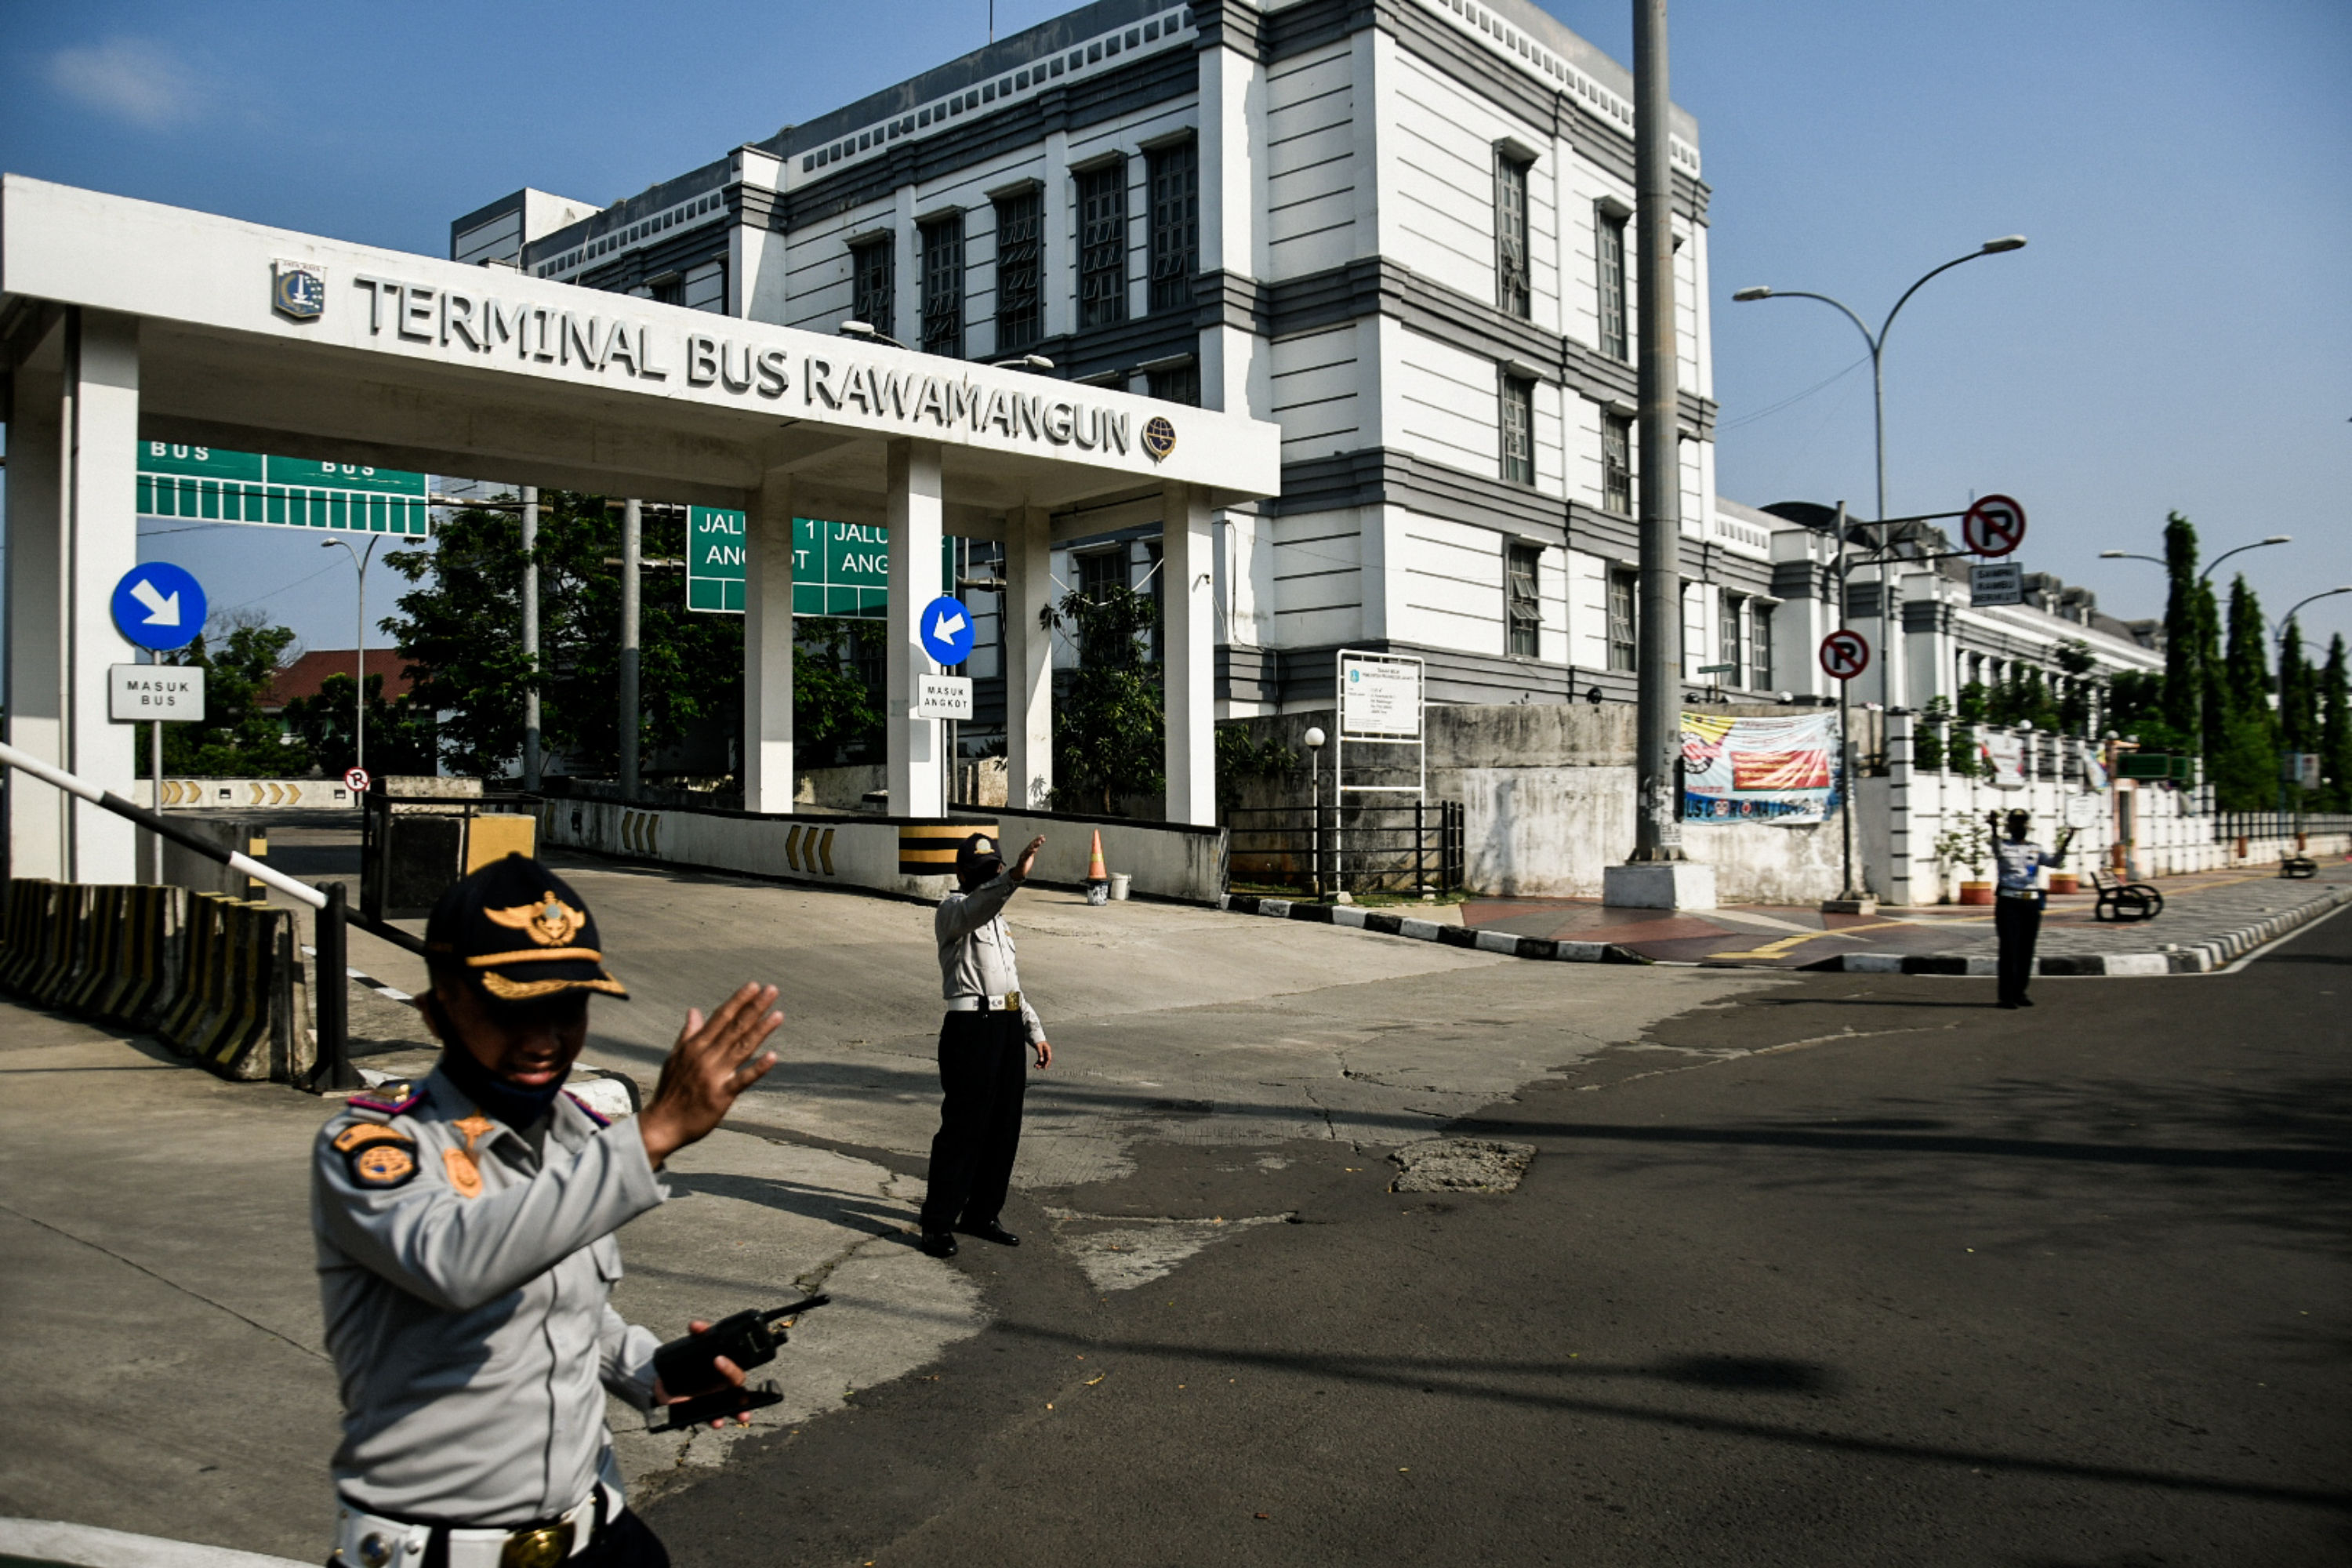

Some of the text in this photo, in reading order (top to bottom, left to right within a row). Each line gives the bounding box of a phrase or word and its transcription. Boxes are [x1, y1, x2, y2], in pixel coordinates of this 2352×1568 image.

[355, 273, 1130, 455] TERMINAL BUS RAWAMANGUN
[151, 441, 209, 461] BUS
[699, 514, 815, 539] JAL 1
[834, 523, 887, 544] JALU
[127, 681, 189, 691] MASUK
[927, 686, 964, 696] MASUK
[141, 695, 176, 706] BUS
[924, 698, 967, 709] ANGKOT
